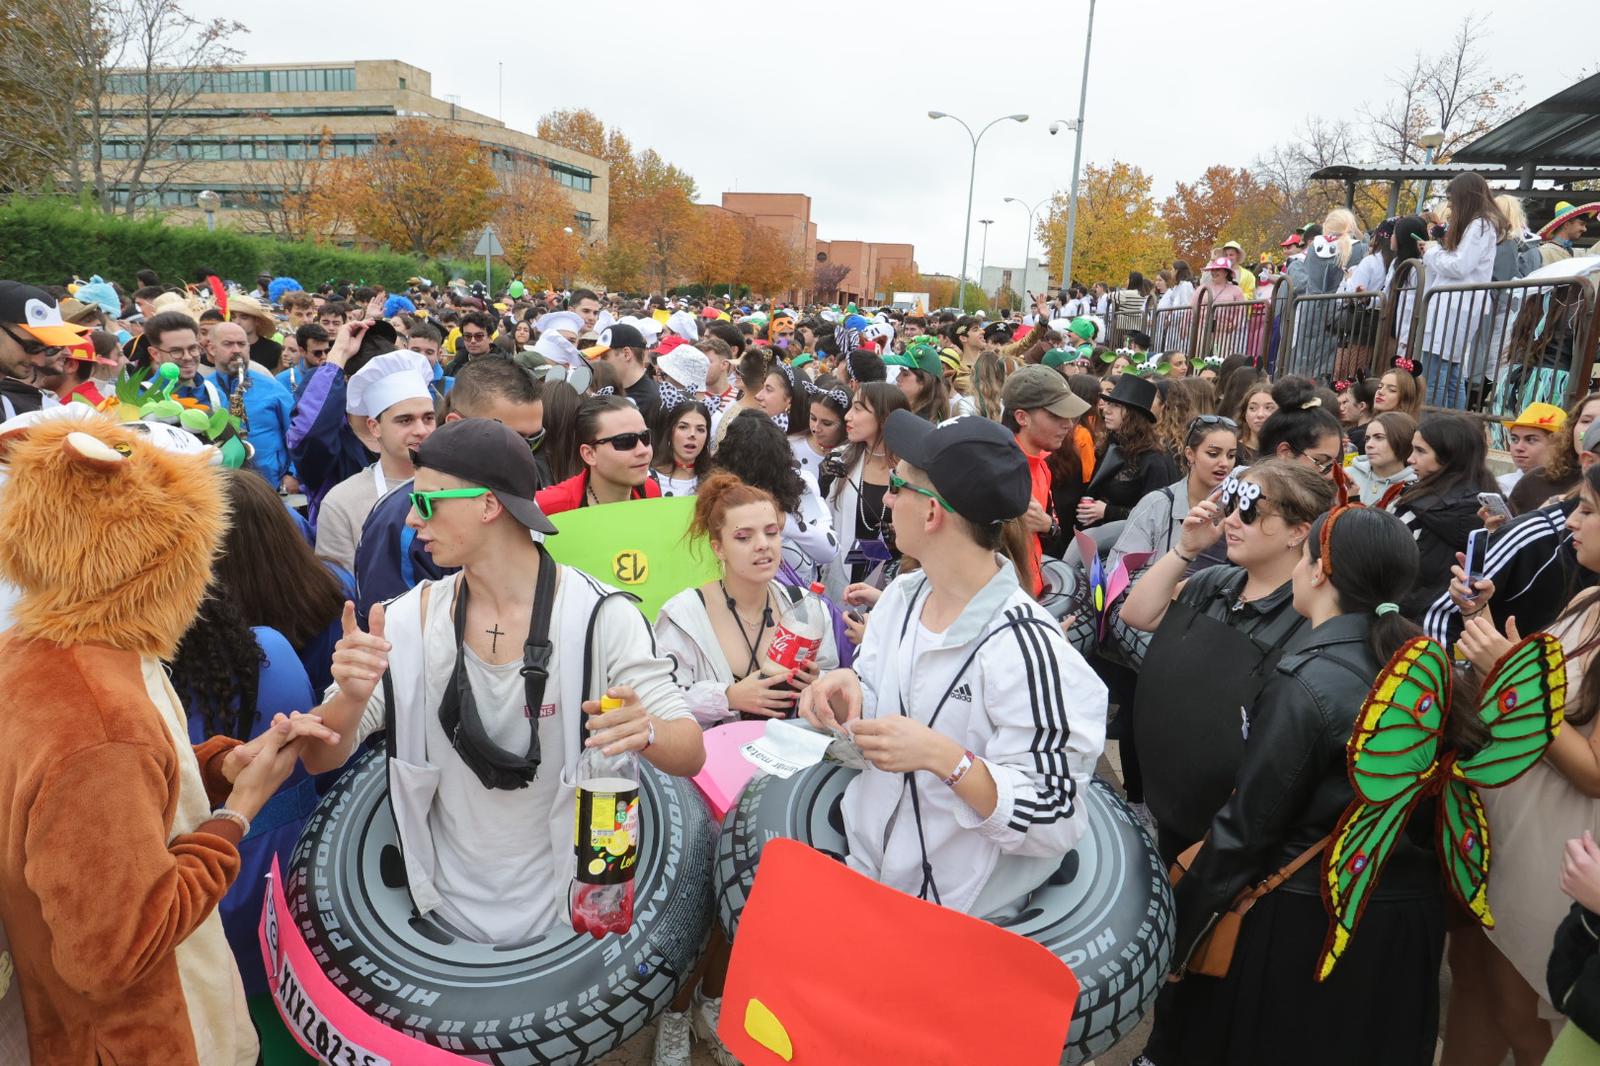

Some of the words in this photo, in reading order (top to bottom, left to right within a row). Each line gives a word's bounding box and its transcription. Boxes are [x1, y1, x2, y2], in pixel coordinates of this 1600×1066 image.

[314, 754, 387, 952] PERFORMAN
[601, 766, 684, 967] RFORMANCE
[349, 954, 442, 1008] HIGH
[1059, 926, 1117, 969] HIG
